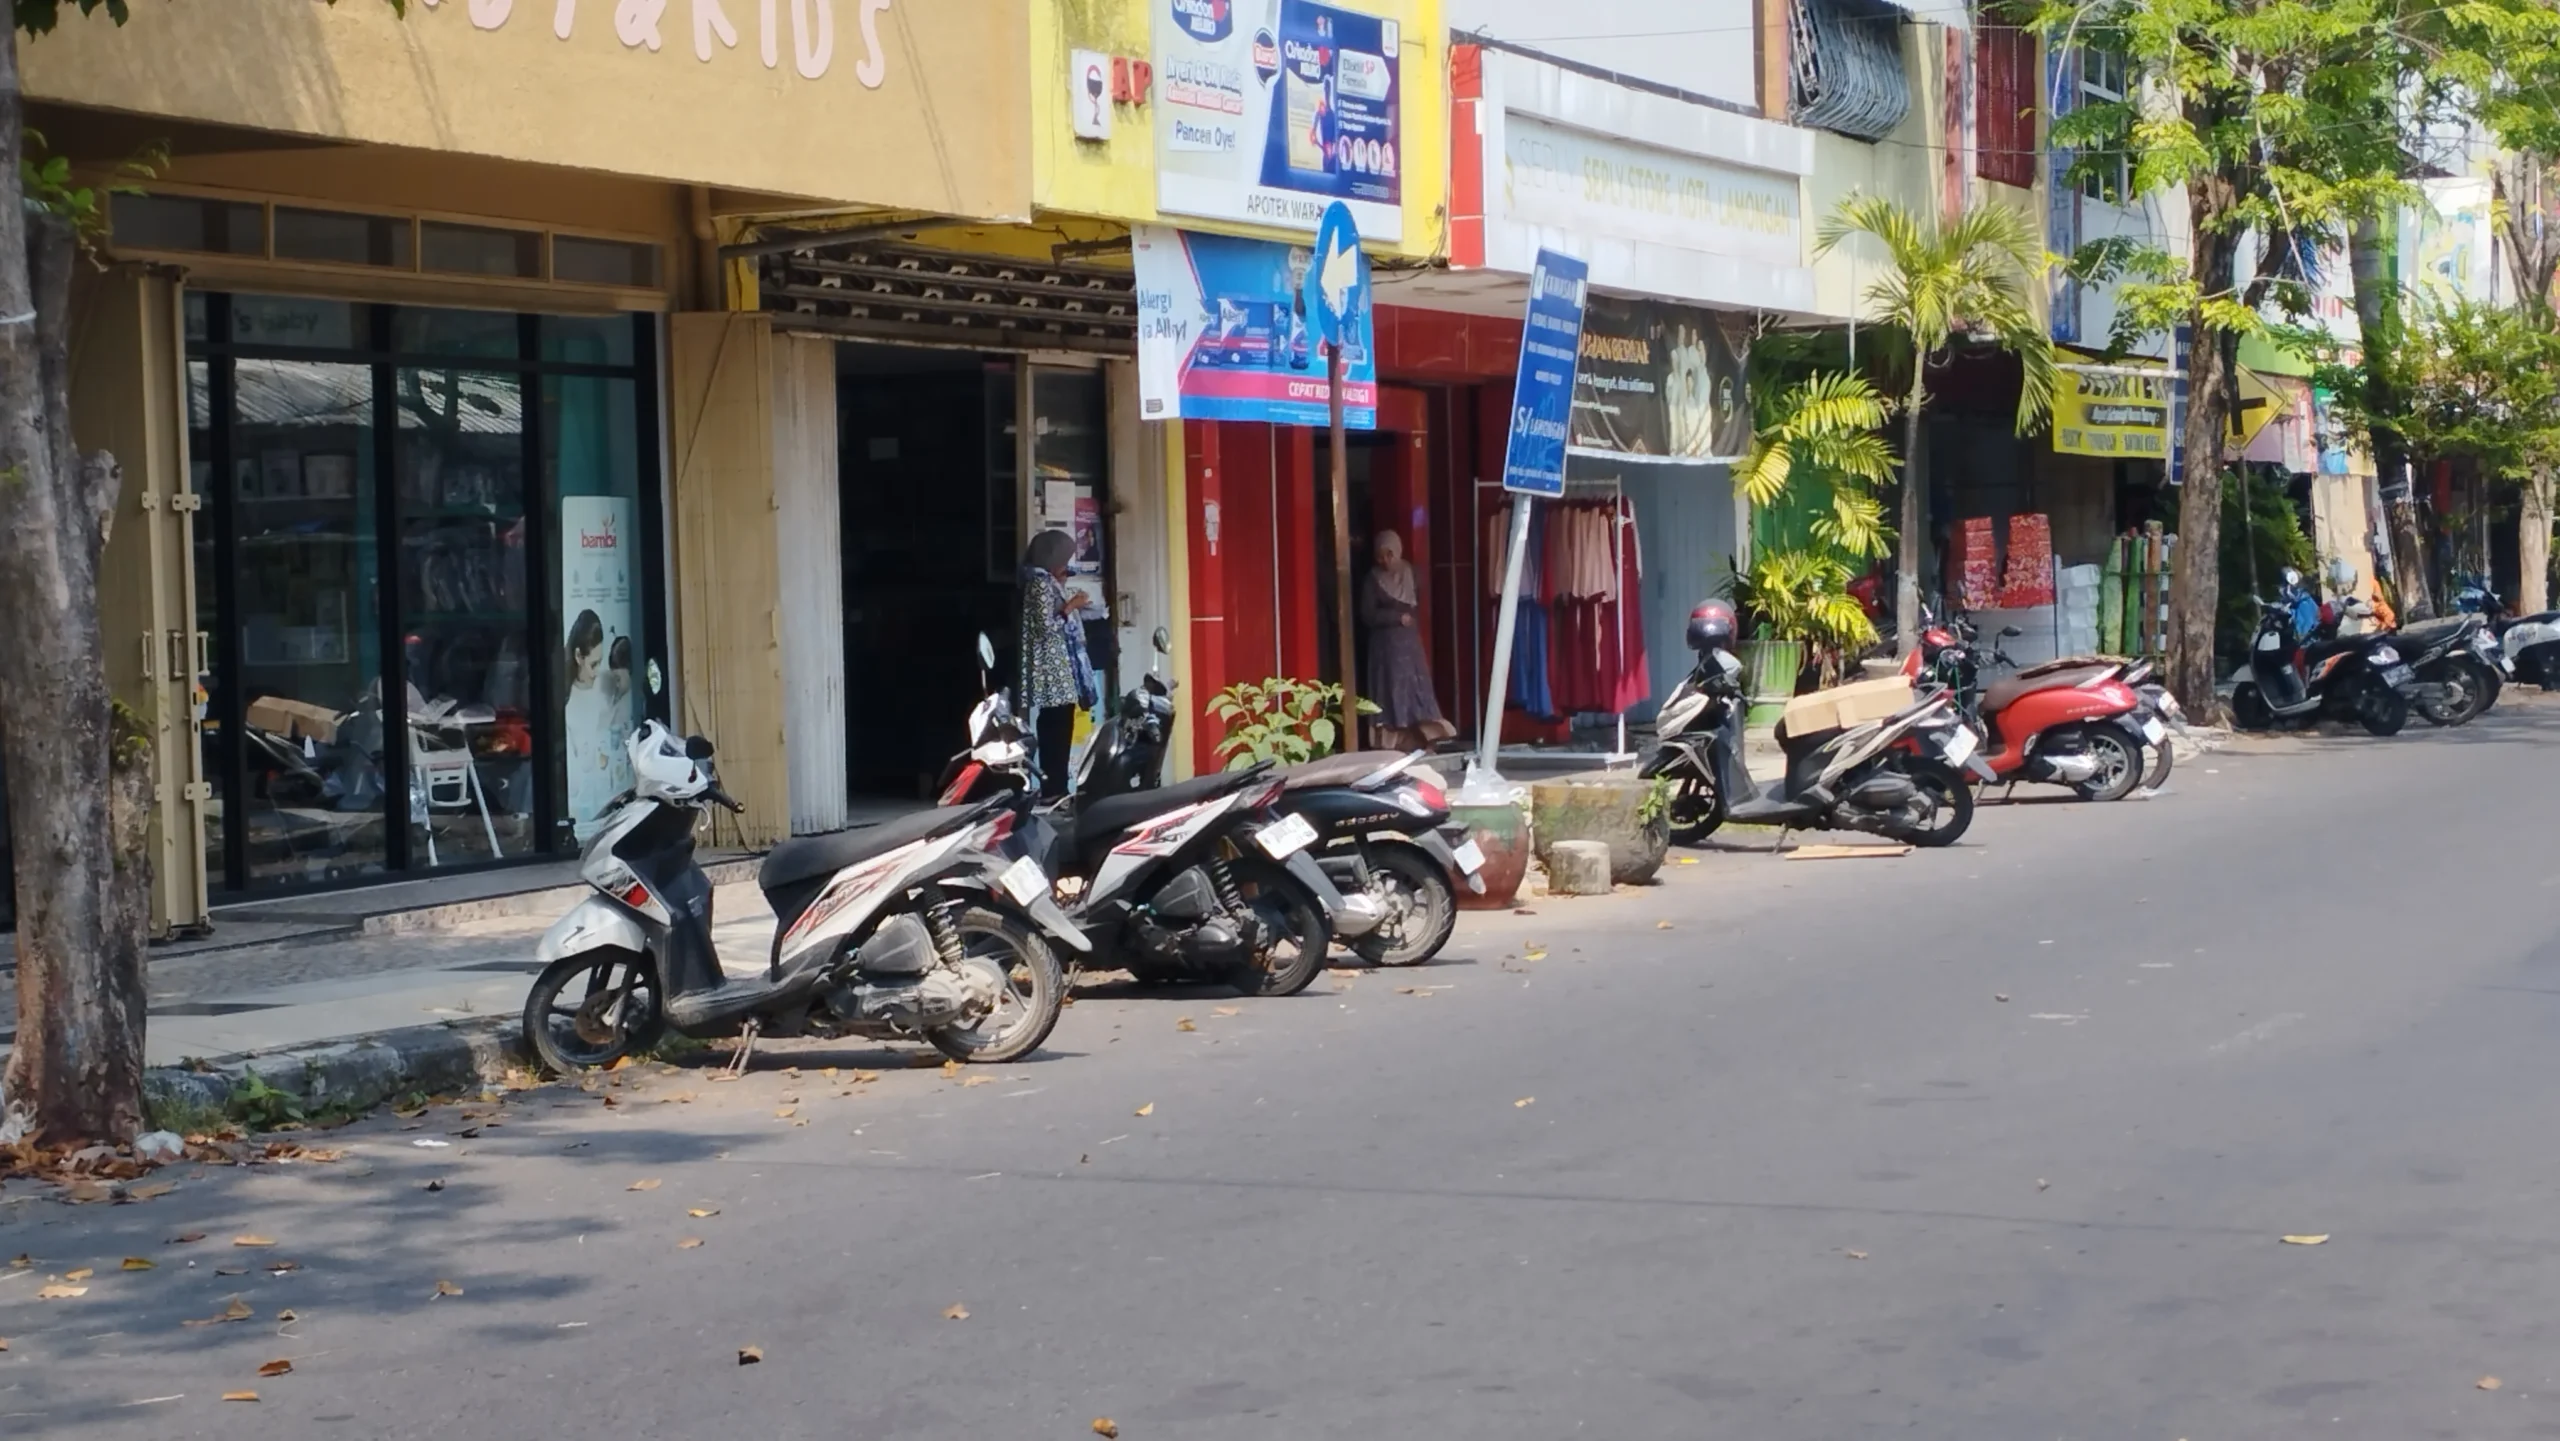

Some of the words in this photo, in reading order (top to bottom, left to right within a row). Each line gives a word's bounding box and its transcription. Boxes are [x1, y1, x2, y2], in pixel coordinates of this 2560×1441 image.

[1111, 57, 1153, 105] AP
[1175, 119, 1212, 145] Pancen
[1214, 125, 1236, 152] Oye!
[1247, 194, 1290, 218] APOTEK
[1583, 156, 1624, 207] SEPLY
[1628, 166, 1674, 216] STORE
[1677, 174, 1713, 222] KOTA
[1717, 186, 1791, 236] LAMONGAN
[581, 528, 617, 549] bambi
